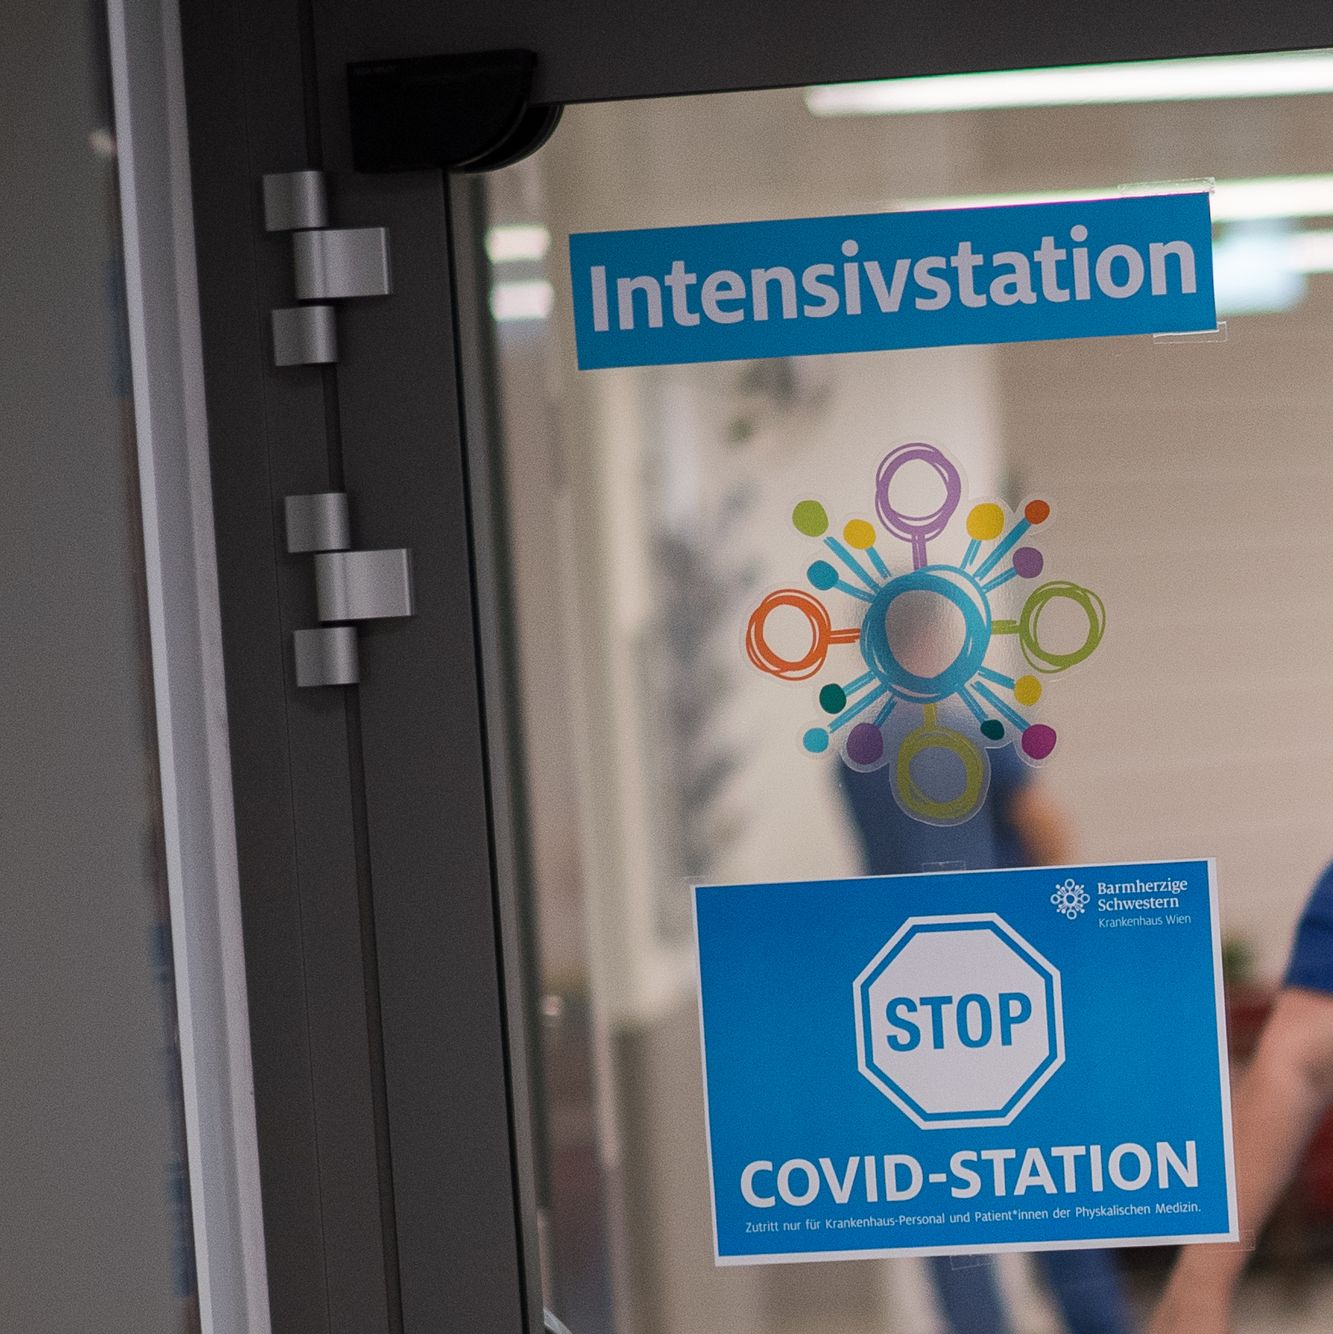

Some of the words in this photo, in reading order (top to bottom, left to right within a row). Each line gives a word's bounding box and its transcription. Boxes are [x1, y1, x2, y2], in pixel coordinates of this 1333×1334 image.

[589, 224, 1198, 333] Intensivstation
[1097, 877, 1188, 895] Barmherzige
[1097, 897, 1180, 912] Schwestern
[1098, 916, 1163, 928] Krankenhaus
[1165, 914, 1192, 925] Wien
[885, 991, 1032, 1053] STOP
[740, 1140, 1199, 1209] COVID-STATION
[745, 1220, 779, 1233] Zutritt
[783, 1222, 802, 1231] nur
[805, 1218, 821, 1230] für
[825, 1213, 945, 1230] Krankenhaus-Personal
[949, 1211, 970, 1224] und
[1052, 1206, 1071, 1219] der
[1075, 1203, 1150, 1220] Physkalischen
[1155, 1201, 1202, 1214] Medizin.
